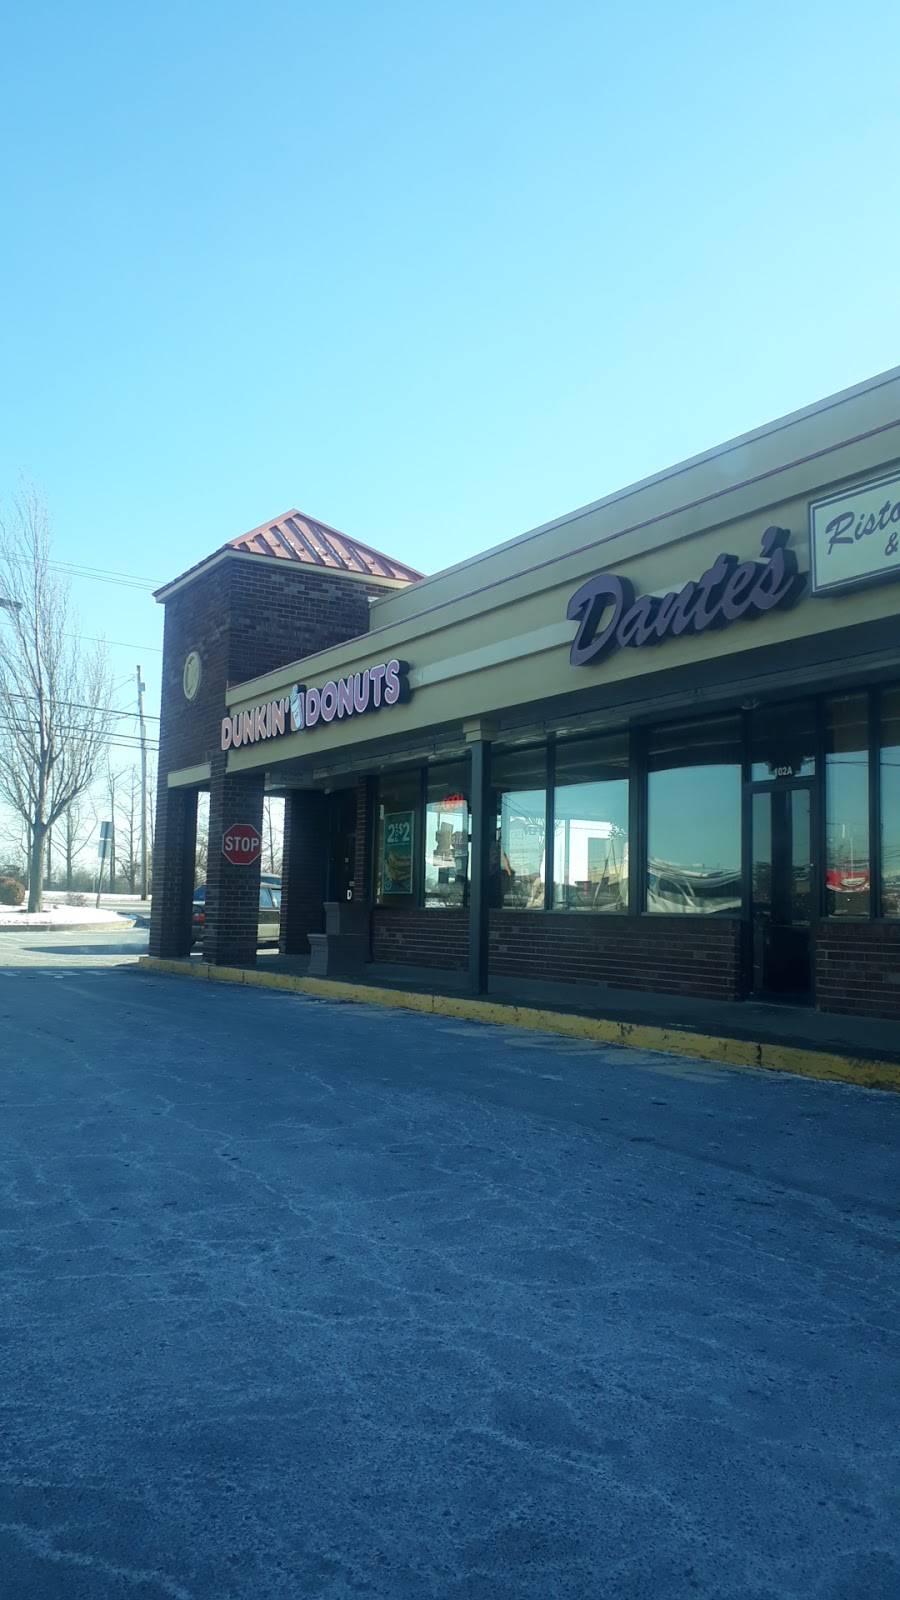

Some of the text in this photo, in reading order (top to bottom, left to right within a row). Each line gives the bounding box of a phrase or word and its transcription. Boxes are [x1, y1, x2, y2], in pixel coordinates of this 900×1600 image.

[885, 532, 898, 556] &
[567, 525, 797, 666] Dante's
[221, 659, 400, 751] DUNKIN' DONUTS
[774, 766, 793, 777] 102A
[225, 836, 259, 852] STOP
